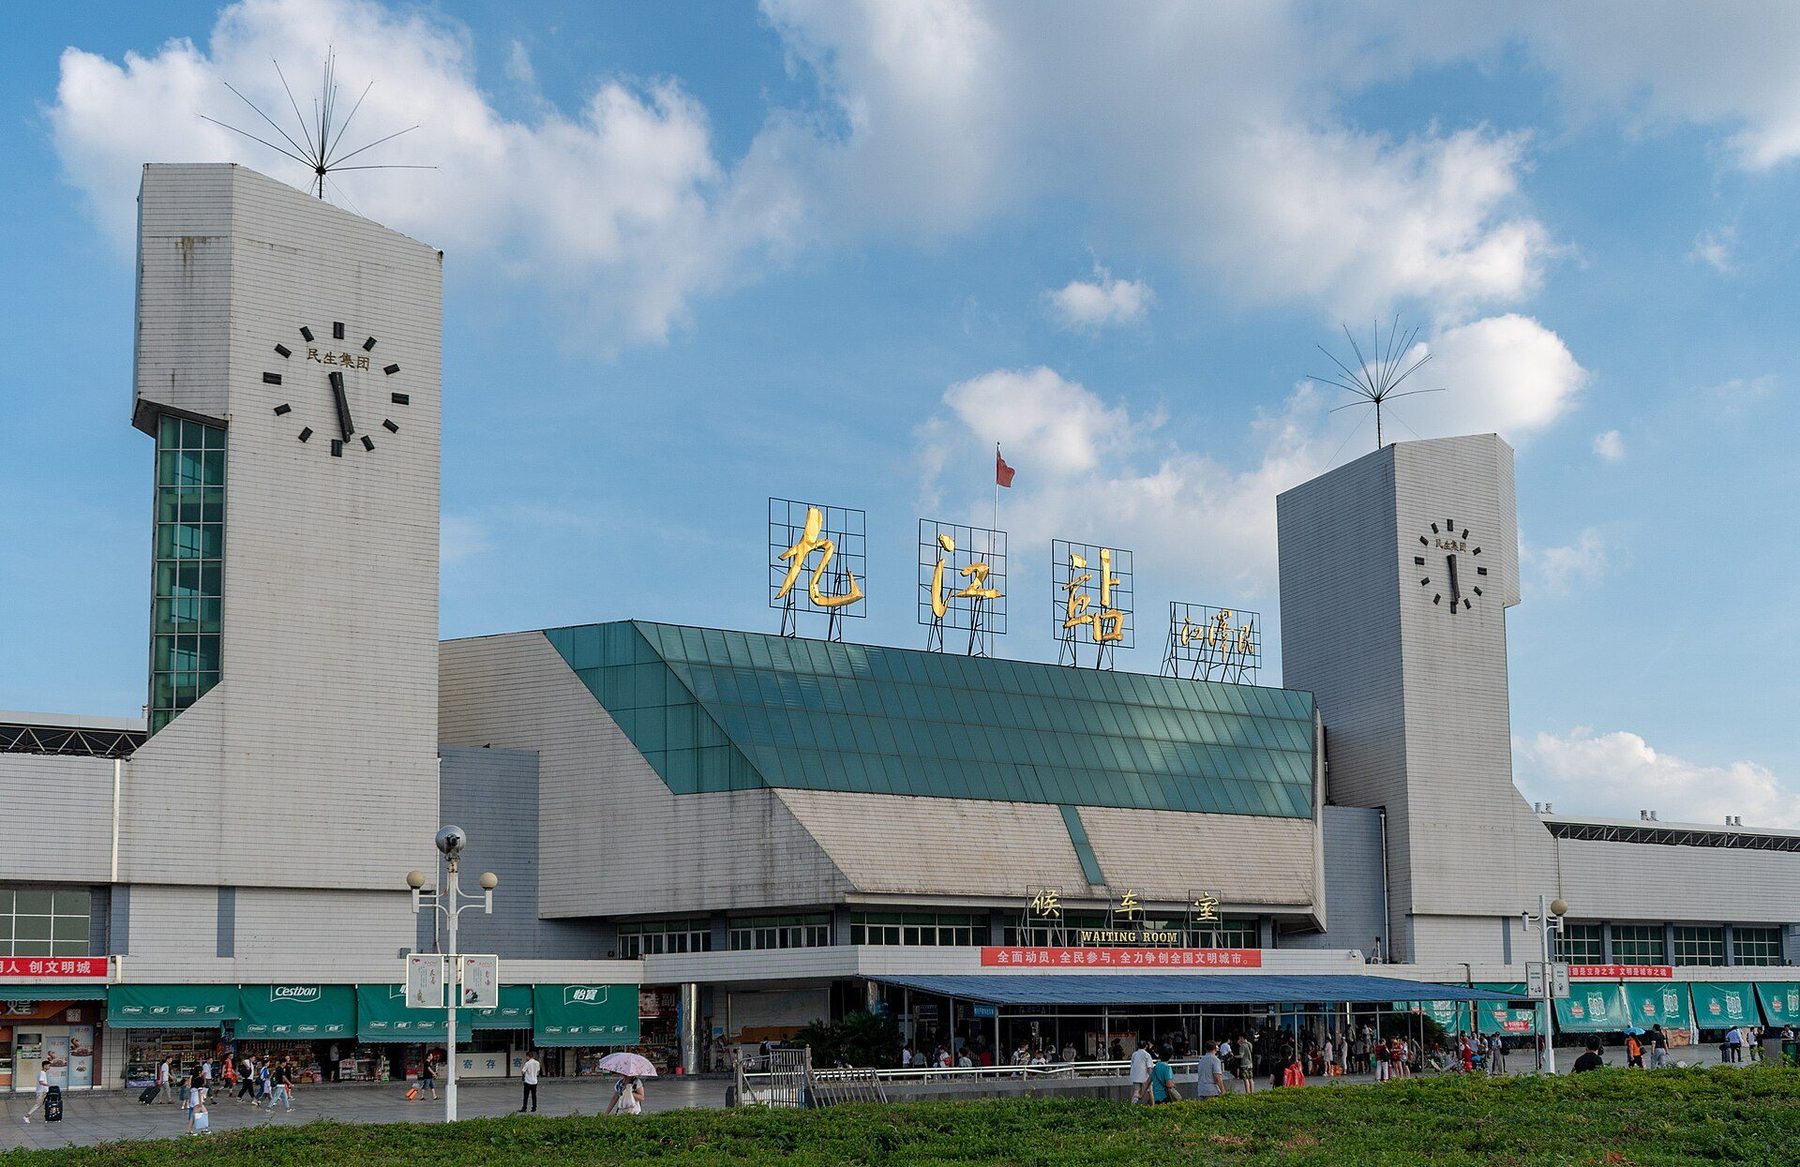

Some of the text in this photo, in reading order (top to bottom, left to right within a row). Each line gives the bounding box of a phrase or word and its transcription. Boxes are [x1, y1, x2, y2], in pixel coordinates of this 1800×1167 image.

[306, 348, 370, 371] 民生集团
[773, 507, 1125, 643] 九江站
[1030, 889, 1220, 921] 候车室
[1081, 931, 1178, 943] WAITING ROOM
[29, 960, 91, 974] 创文明城
[1568, 967, 1615, 976] 德是立身之本
[463, 1058, 496, 1070] 寄存
